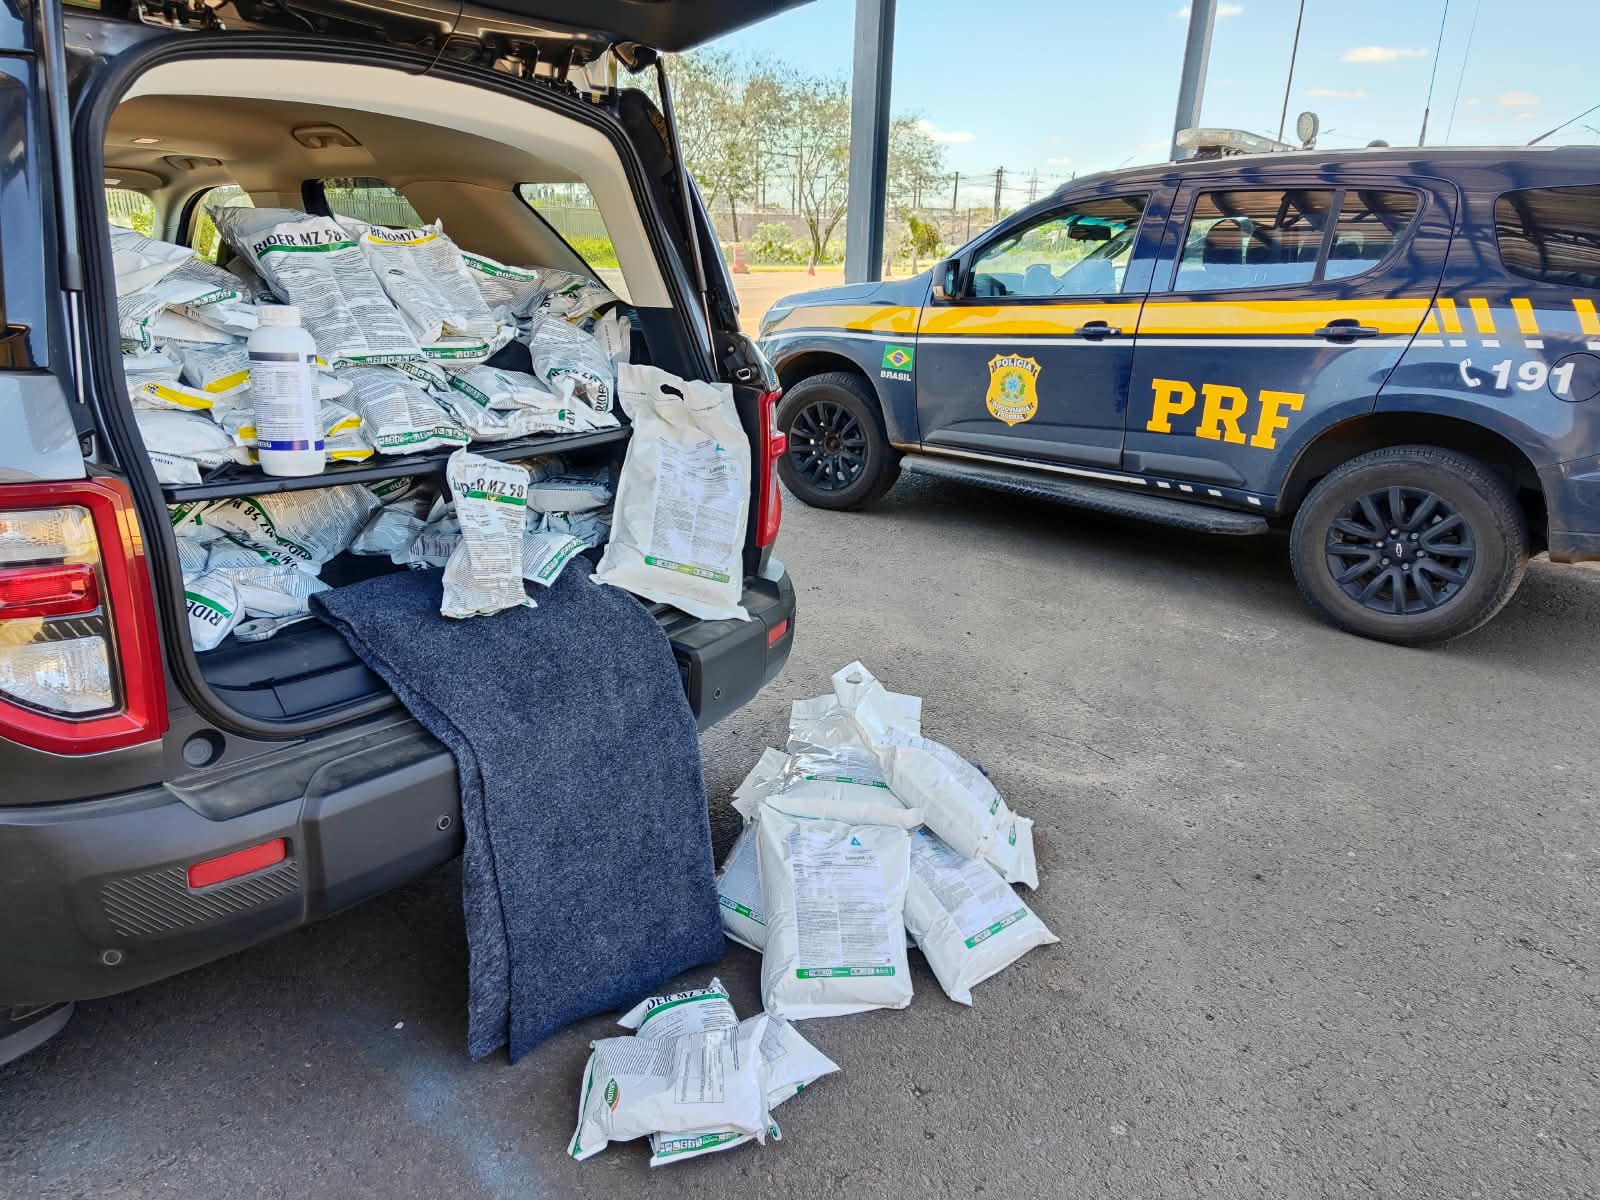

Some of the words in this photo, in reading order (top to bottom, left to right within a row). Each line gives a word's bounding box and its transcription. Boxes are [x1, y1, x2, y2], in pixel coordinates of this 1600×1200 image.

[253, 234, 296, 253] RIDER
[300, 231, 323, 246] MZ
[880, 370, 912, 382] BRASIL
[1491, 359, 1576, 395] 191
[1146, 378, 1305, 450] PRF
[487, 479, 507, 495] MZ
[244, 506, 262, 521] 58
